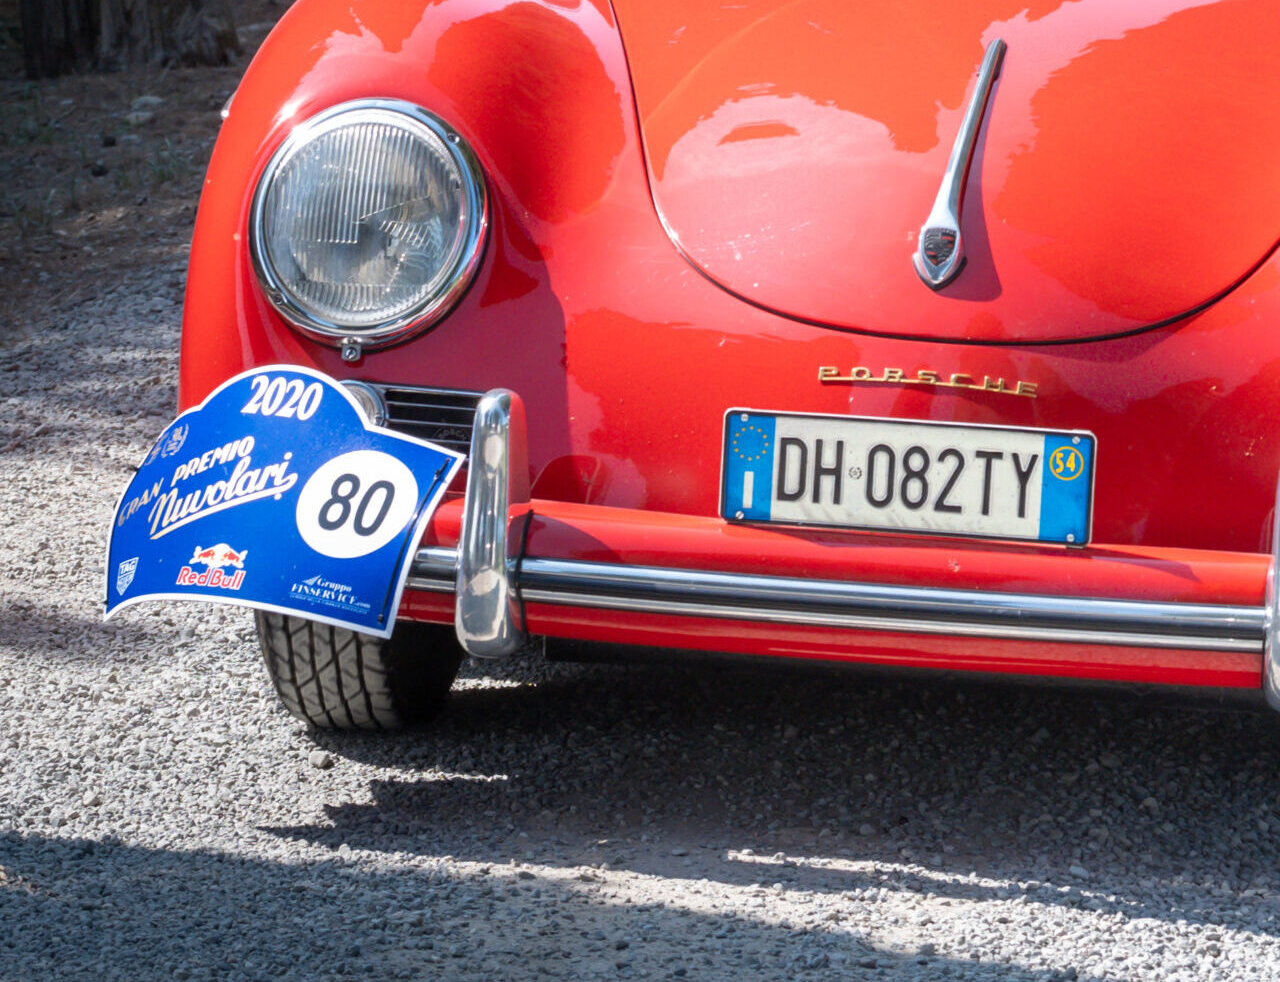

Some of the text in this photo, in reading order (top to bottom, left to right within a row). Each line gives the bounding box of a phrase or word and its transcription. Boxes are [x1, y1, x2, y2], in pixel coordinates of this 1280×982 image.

[241, 375, 324, 421] 2020
[819, 366, 1038, 398] PORSCHE
[118, 478, 164, 528] GRAN
[170, 435, 255, 488] PREMIO
[777, 437, 1038, 518] DH 082TY
[1056, 452, 1075, 473] 54
[148, 452, 299, 540] Nuvolari
[318, 473, 396, 537] 80
[176, 566, 247, 590] Red Bull
[317, 577, 352, 593] Gruppo
